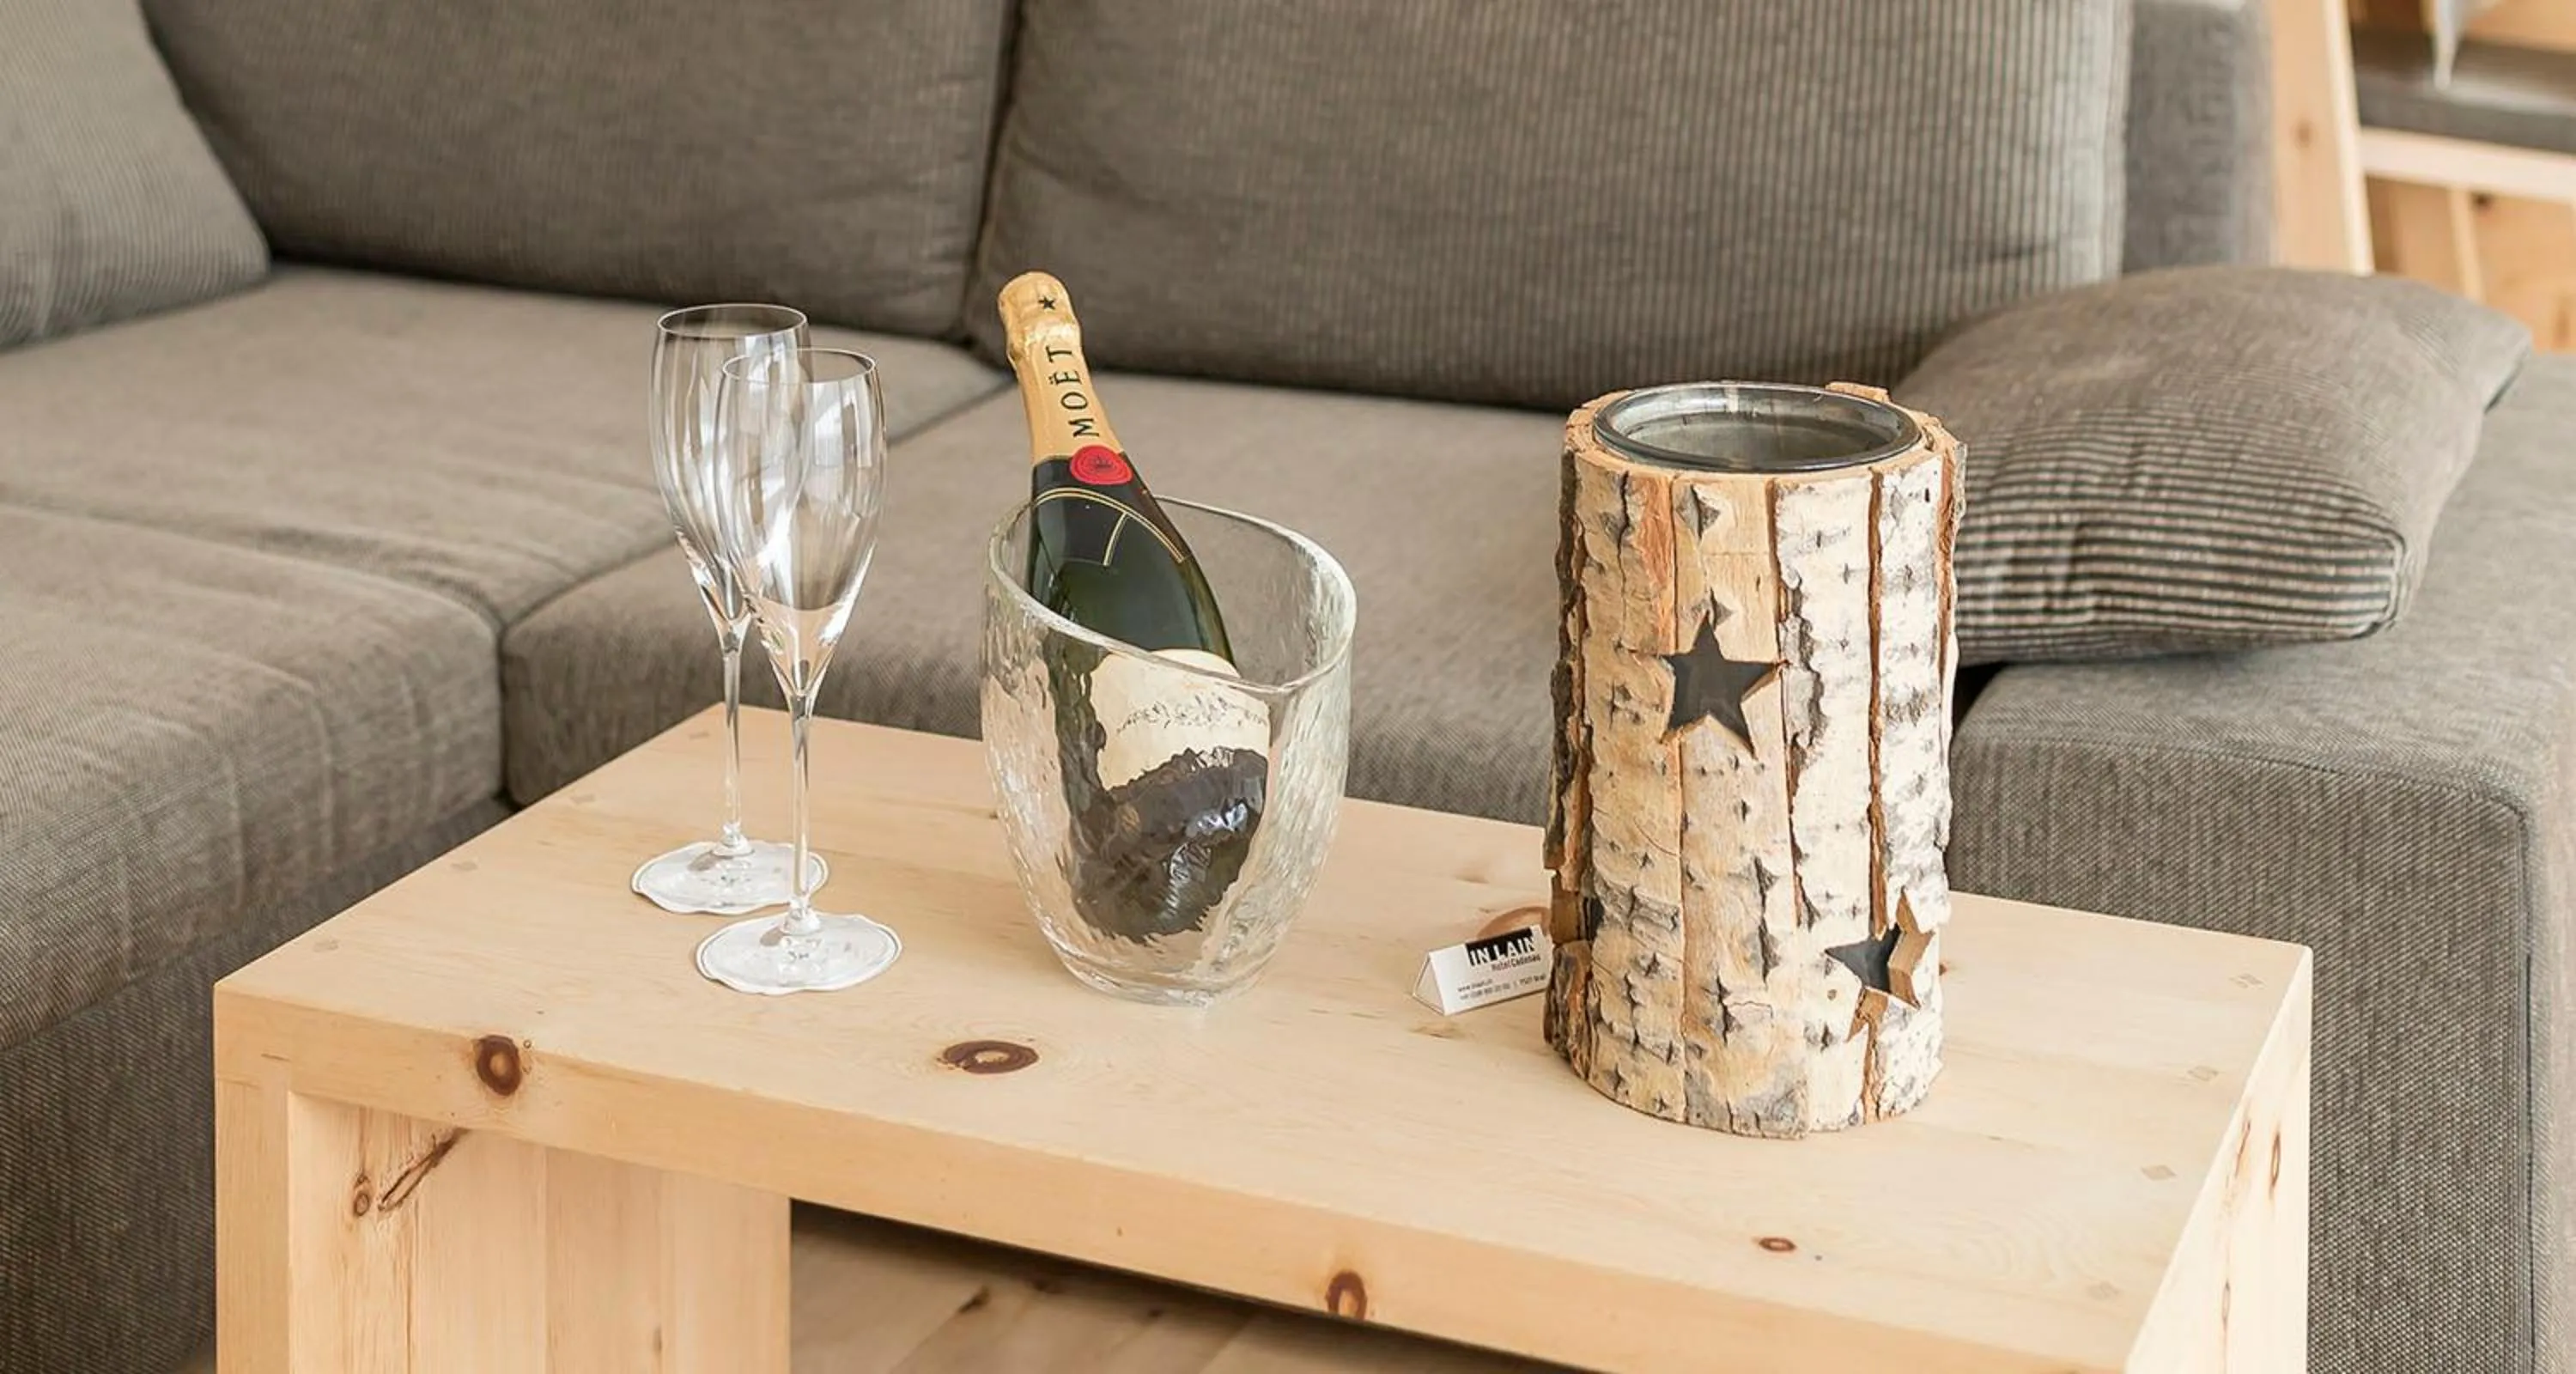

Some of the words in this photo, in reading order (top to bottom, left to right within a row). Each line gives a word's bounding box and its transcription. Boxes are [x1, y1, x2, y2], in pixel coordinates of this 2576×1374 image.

[1045, 344, 1100, 438] MOËT
[1469, 946, 1491, 966] IN
[1494, 936, 1536, 959] LAIN
